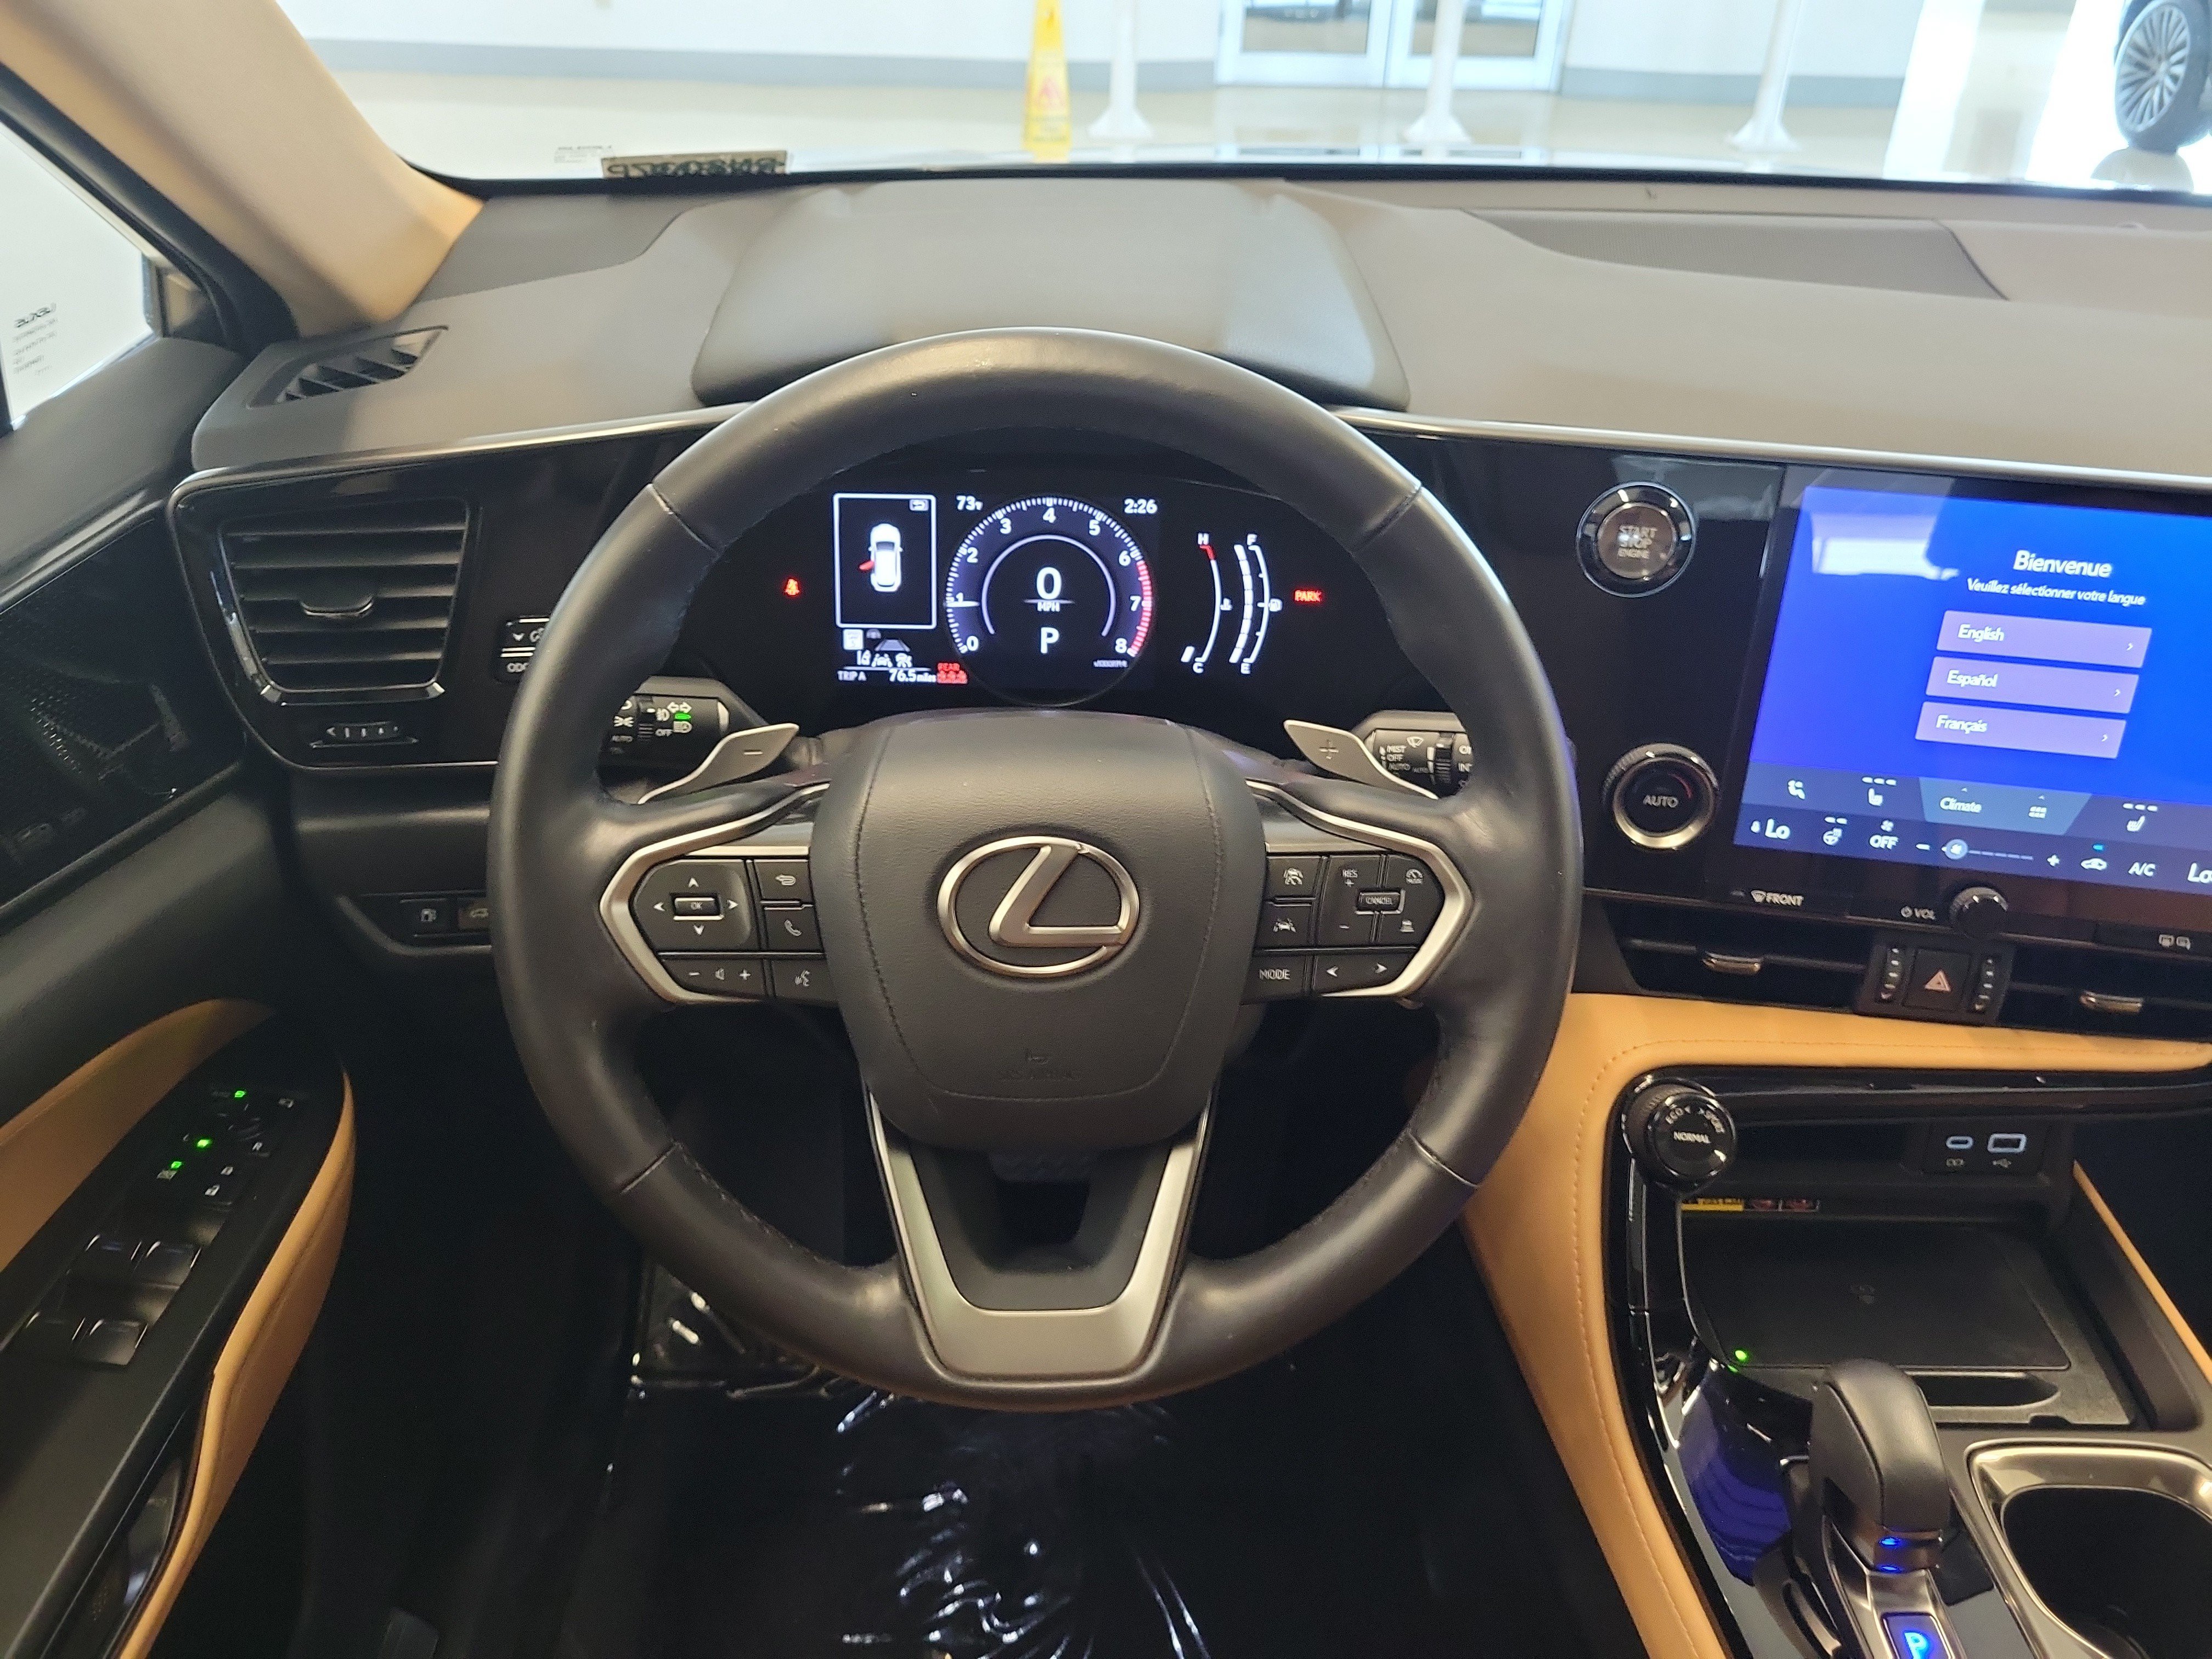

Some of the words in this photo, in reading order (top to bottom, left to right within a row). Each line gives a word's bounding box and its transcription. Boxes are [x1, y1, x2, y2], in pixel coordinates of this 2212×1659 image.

[1124, 499, 1158, 514] 2:26
[1042, 507, 1056, 522] 4
[1000, 518, 1012, 533] 3
[1089, 520, 1101, 535] 5
[1198, 533, 1209, 544] H
[1247, 534, 1257, 545] F
[967, 548, 978, 562] 2
[1119, 551, 1131, 566] 6
[2013, 549, 2112, 578] Bienvenue
[1036, 567, 1062, 600] 0
[1295, 590, 1322, 602] PARK
[1967, 578, 2010, 594] Veuillez
[2010, 582, 2076, 600] sélectionner
[2077, 591, 2107, 602] votre
[2107, 590, 2146, 607] langue
[1037, 602, 1060, 612] MPH
[1130, 596, 1141, 611] 7
[1040, 627, 1059, 654] P
[1958, 624, 2004, 642] English
[967, 636, 979, 651] 0
[1115, 638, 1127, 653] 8
[837, 670, 855, 681] TRIP
[858, 671, 867, 681] A
[889, 669, 916, 681] 76.5
[1193, 663, 1203, 673] C
[1240, 663, 1251, 674] E
[1947, 669, 1998, 687] Español
[1936, 714, 1988, 734] Français
[1643, 795, 1678, 808] AUTO
[1939, 797, 1982, 813] Climate
[1870, 834, 1899, 850] OFF
[2128, 861, 2156, 877] A/C
[1766, 893, 1804, 906] FRONT
[1259, 969, 1290, 980] MODE
